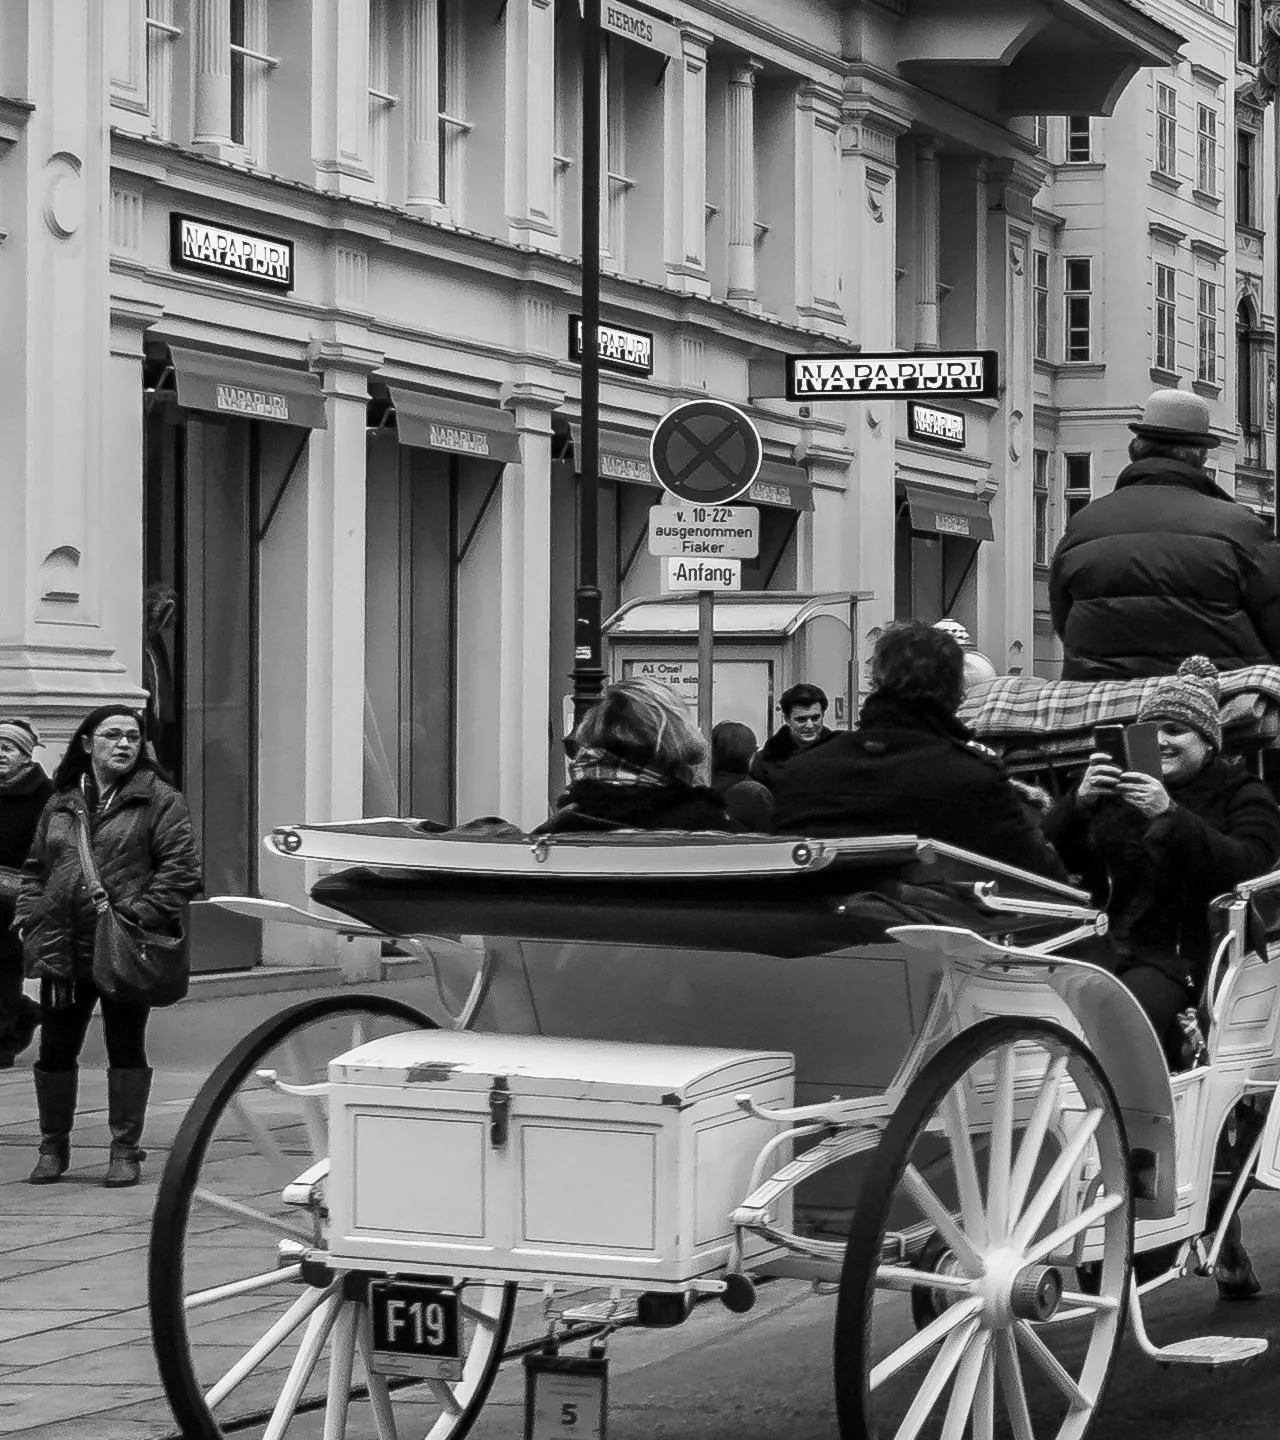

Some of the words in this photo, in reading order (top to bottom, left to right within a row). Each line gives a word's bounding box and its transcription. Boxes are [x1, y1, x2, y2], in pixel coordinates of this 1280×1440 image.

[184, 226, 289, 280] NAPAPIJRI
[582, 329, 650, 366] PAPIJRI
[800, 362, 981, 391] NAPAPIJRI
[676, 511, 686, 522] v.
[655, 526, 753, 540] ausgenommen
[682, 541, 725, 553] Fiaker
[676, 562, 732, 587] Anfang
[386, 1299, 445, 1346] F19
[560, 1402, 579, 1426] 5
